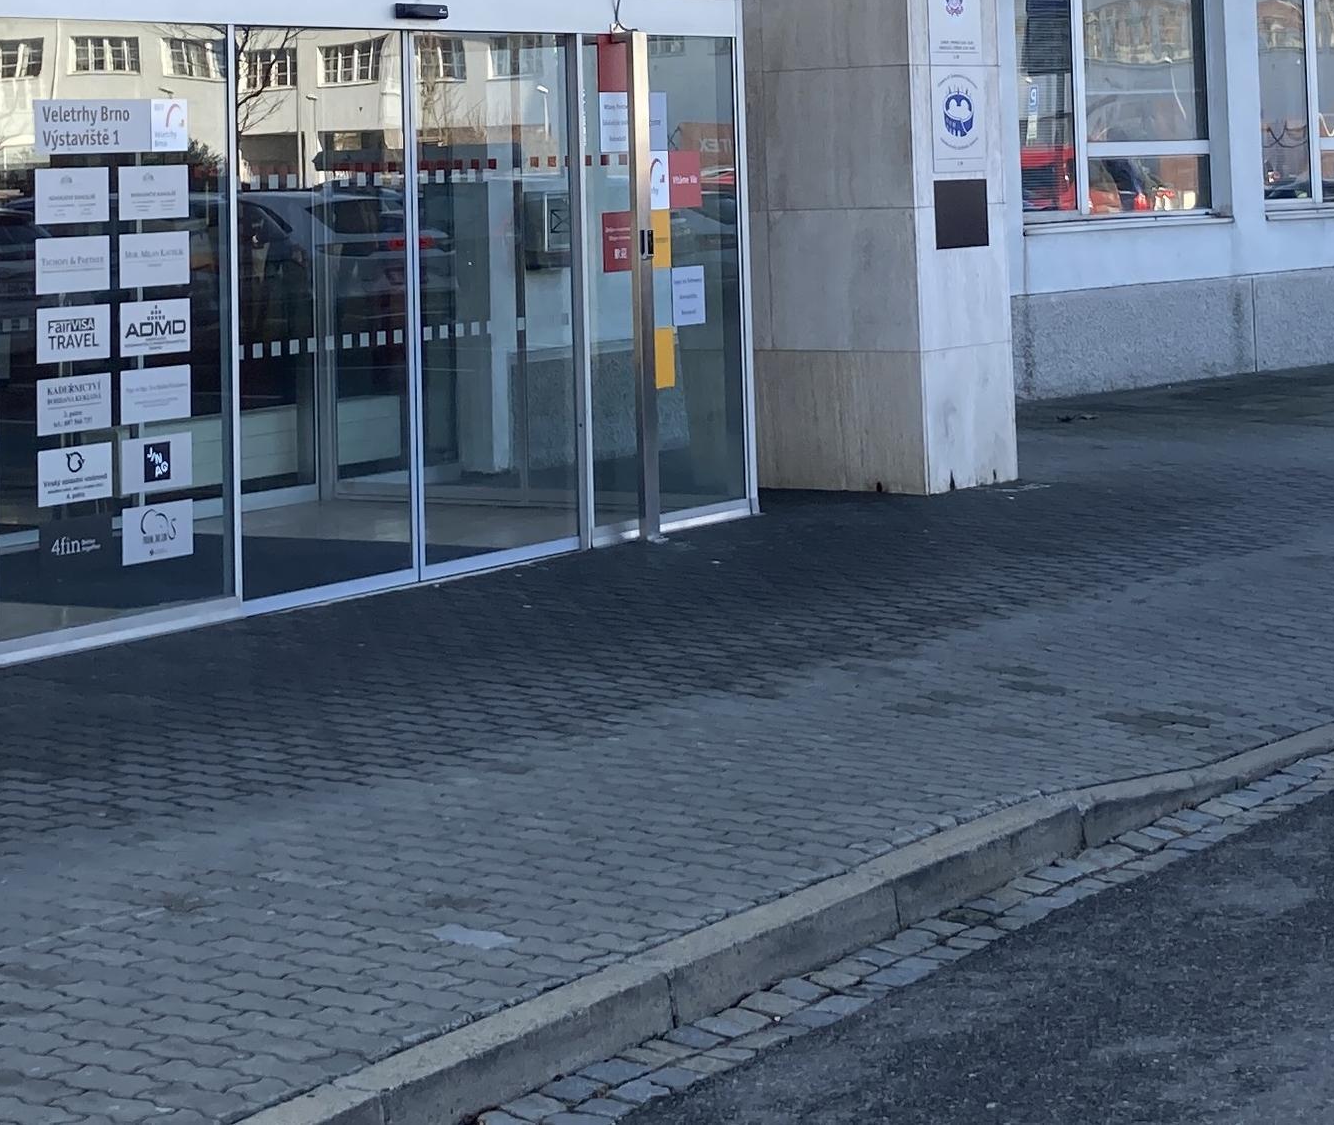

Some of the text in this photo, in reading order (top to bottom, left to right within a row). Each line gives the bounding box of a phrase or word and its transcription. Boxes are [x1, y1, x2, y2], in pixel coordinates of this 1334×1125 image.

[42, 106, 129, 126] Veletrhy Brno
[43, 129, 120, 151] Výstaviště 1
[125, 320, 186, 338] ADMD
[48, 332, 99, 350] TRAVEL
[51, 536, 81, 555] 4fin
